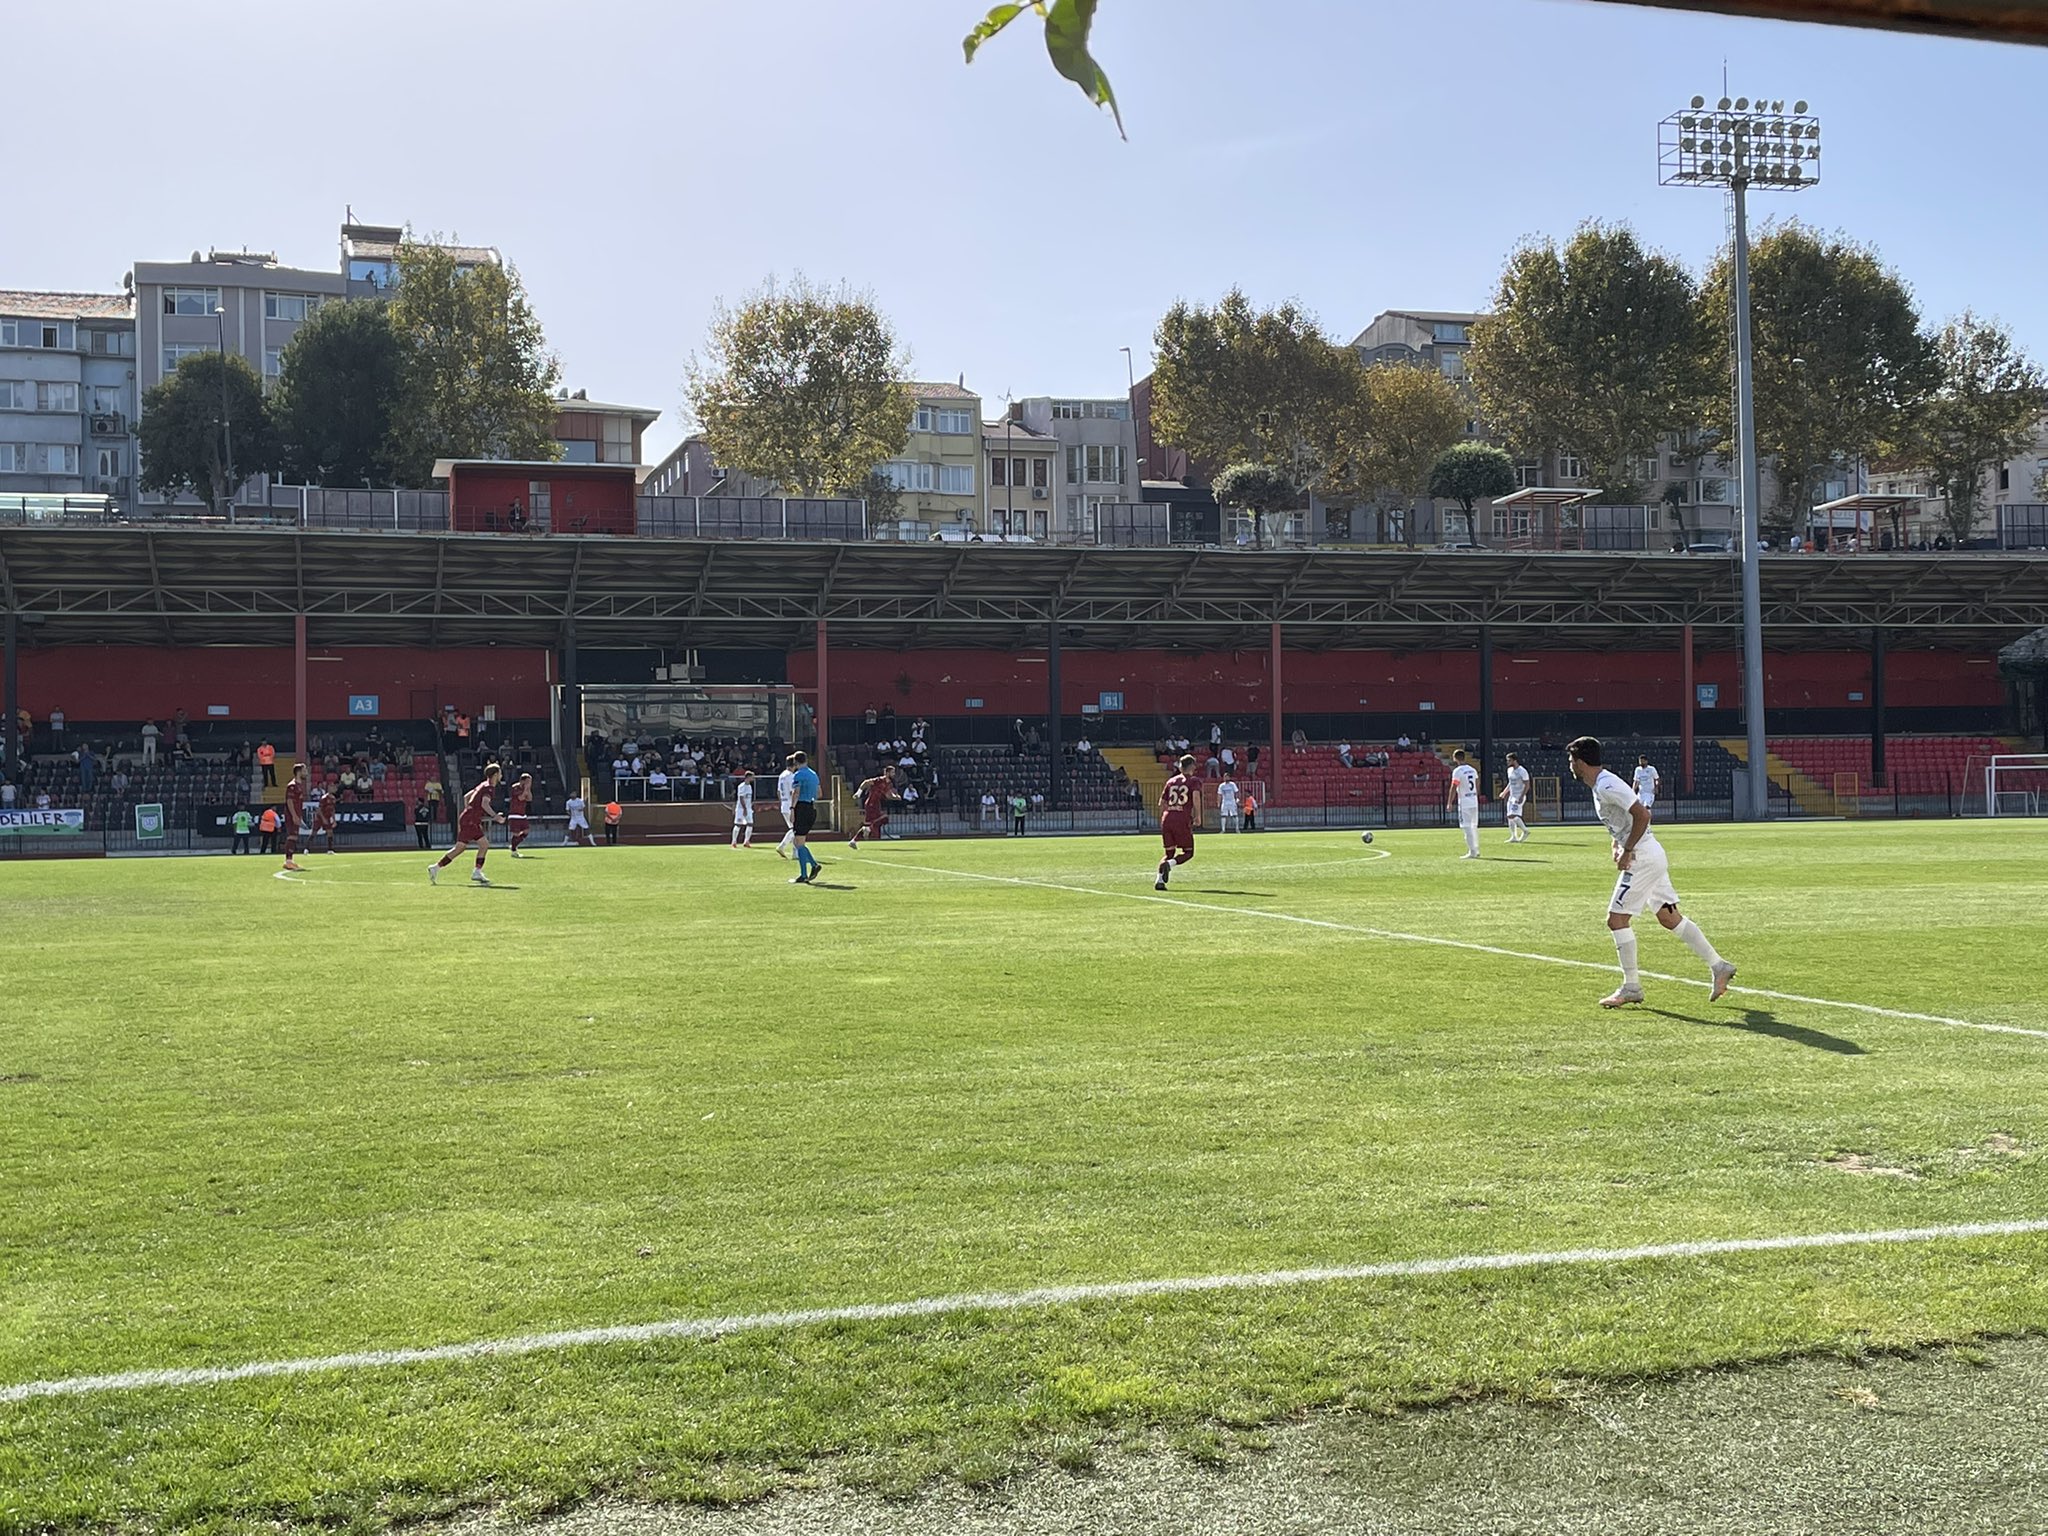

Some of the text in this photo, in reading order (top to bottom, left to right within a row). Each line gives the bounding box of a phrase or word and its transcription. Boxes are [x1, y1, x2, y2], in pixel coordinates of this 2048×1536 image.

[355, 699, 373, 711] A3
[1468, 775, 1475, 791] 5
[1168, 784, 1189, 806] 53
[1618, 884, 1631, 900] 7
